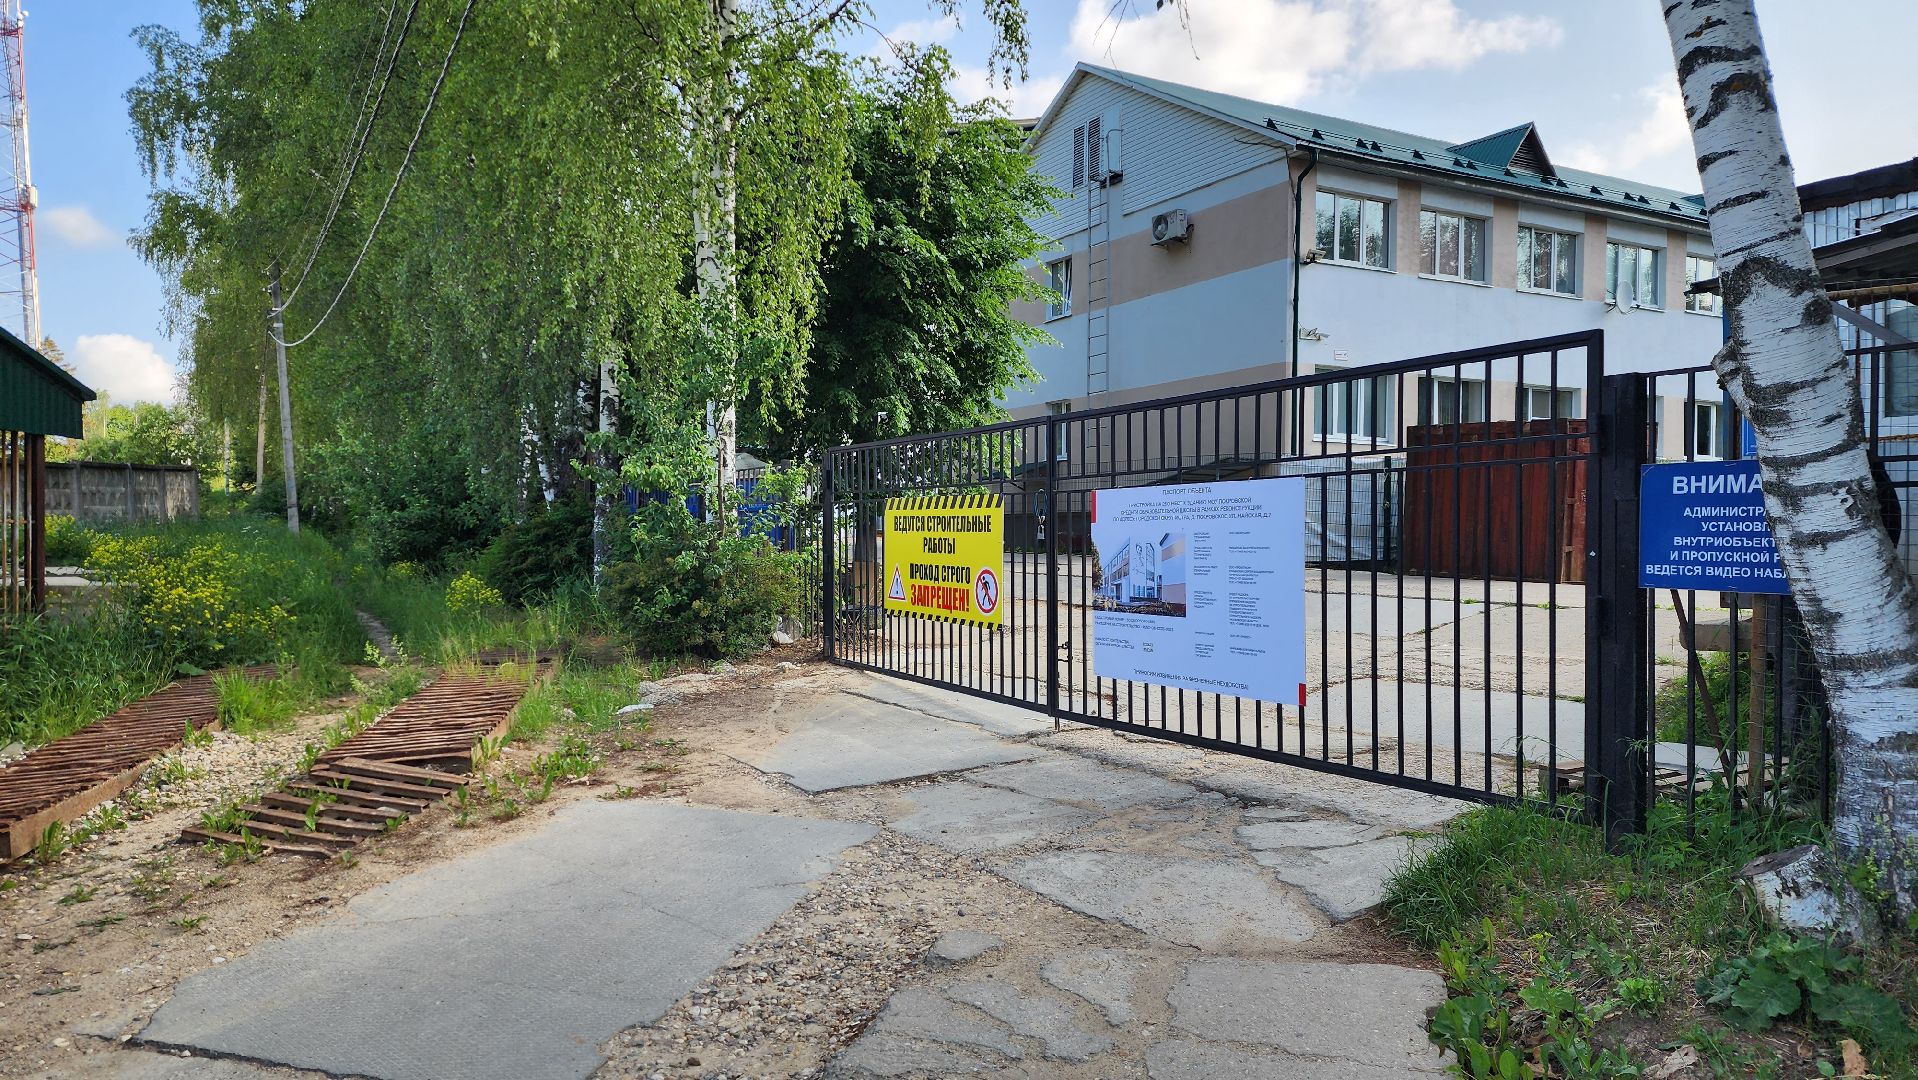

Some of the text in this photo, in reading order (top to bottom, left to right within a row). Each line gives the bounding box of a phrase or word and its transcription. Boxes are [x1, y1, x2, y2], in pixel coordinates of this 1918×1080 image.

[893, 514, 992, 534] ВЕДУТСЯ СТРОИТЕЛЬНЫЕ
[923, 537, 956, 554] РАБОТЫ
[1670, 551, 1678, 561] И
[1681, 550, 1769, 563] ПРОПУСКНОЙ
[909, 563, 971, 584] ПРОХОД СТРОГО
[1645, 564, 1702, 576] ВЕДЕТСЯ
[1705, 566, 1751, 578] ВИДЕО
[910, 584, 970, 614] ЗАПРЕЩЕН!
